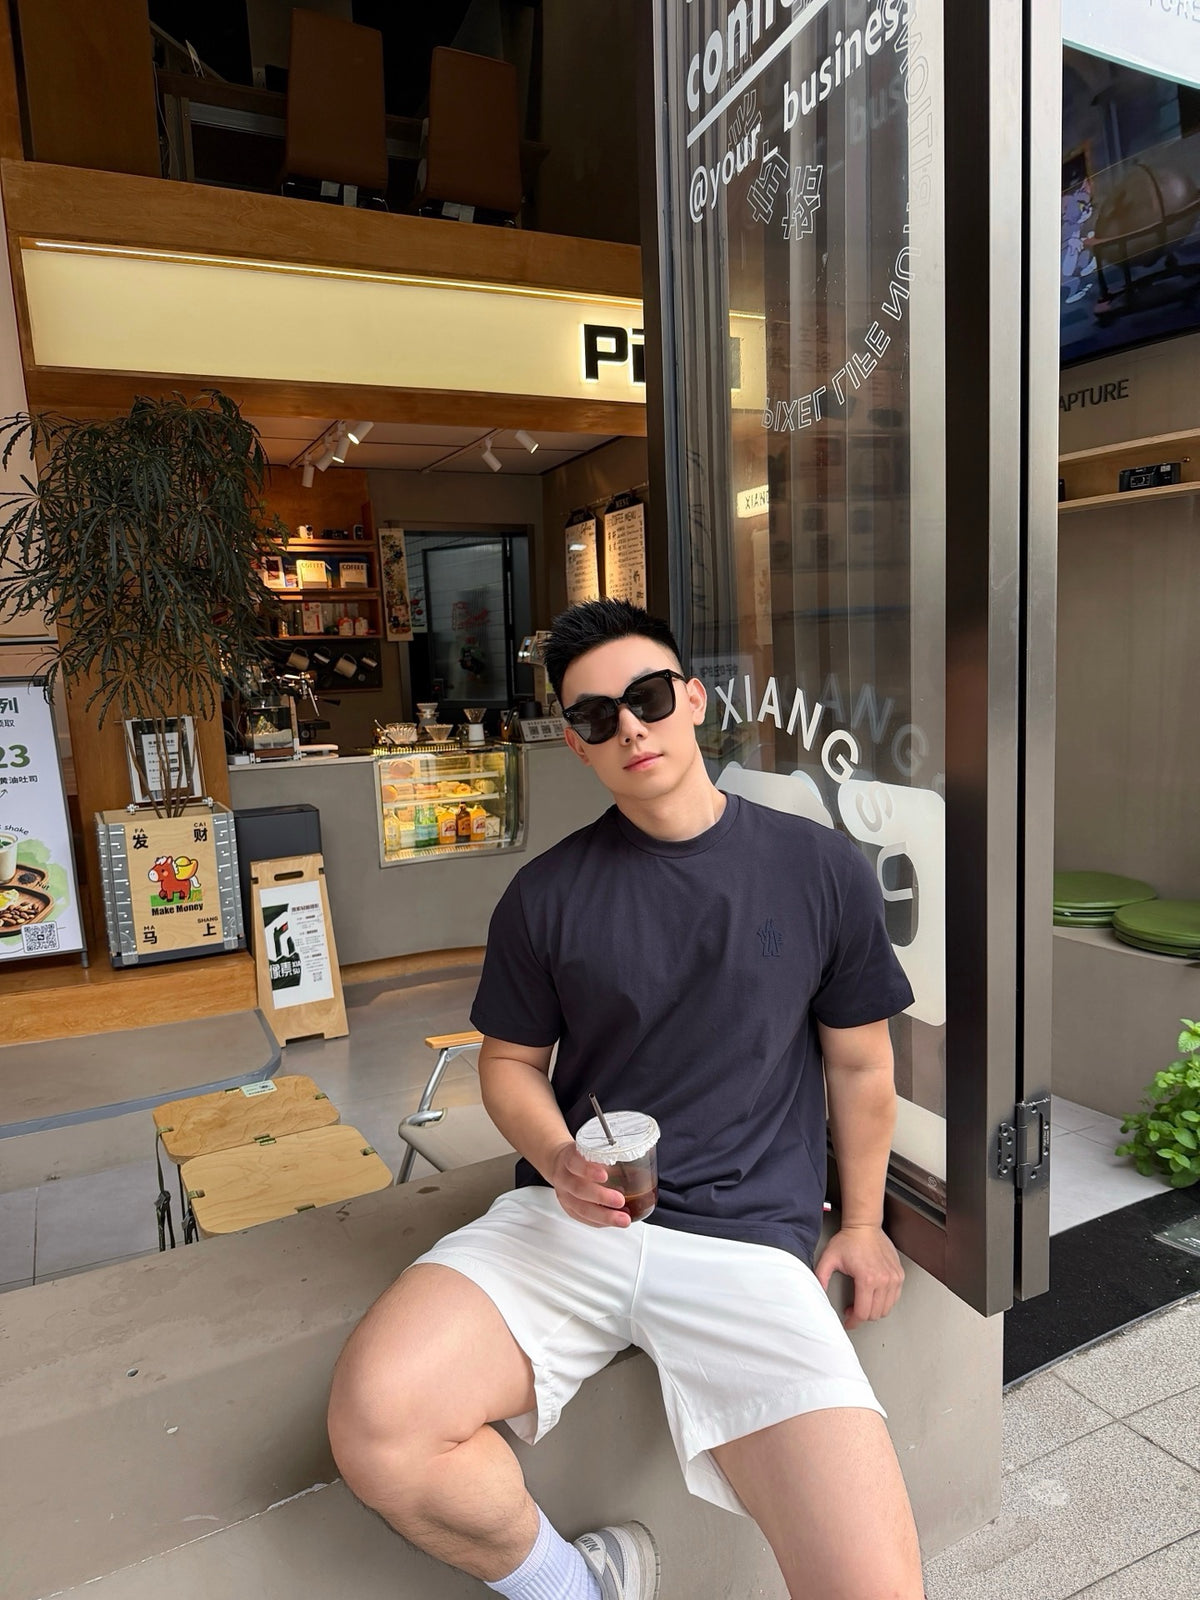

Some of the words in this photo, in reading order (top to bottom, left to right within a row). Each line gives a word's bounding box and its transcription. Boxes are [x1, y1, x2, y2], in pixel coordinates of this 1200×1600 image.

[5, 825, 29, 836] shake
[193, 828, 208, 842] 财
[132, 834, 149, 850] 发
[151, 905, 175, 916] Make
[176, 903, 204, 913] Money
[197, 916, 219, 924] SHANG
[203, 922, 217, 937] 上
[143, 930, 158, 945] 马
